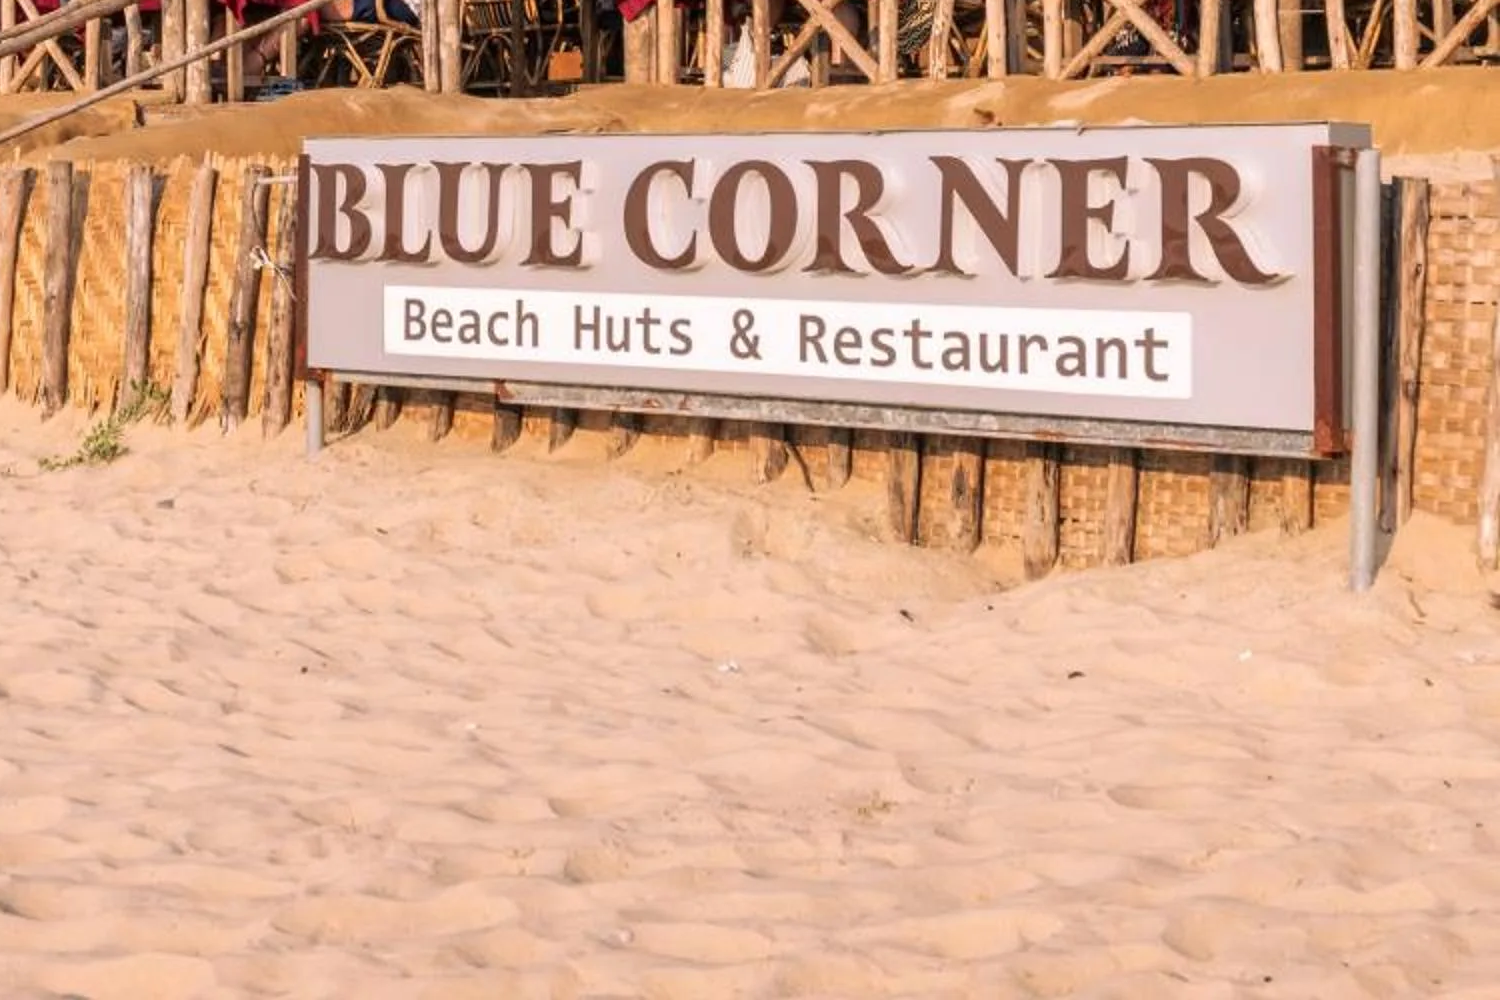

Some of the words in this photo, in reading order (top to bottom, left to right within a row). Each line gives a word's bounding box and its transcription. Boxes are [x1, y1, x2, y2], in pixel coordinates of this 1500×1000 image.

[309, 160, 584, 270] BLUE
[623, 155, 1290, 286] CORNER
[402, 299, 540, 348] Beach
[575, 306, 693, 357] Huts
[729, 310, 763, 361] &
[799, 316, 1170, 383] Restaurant
